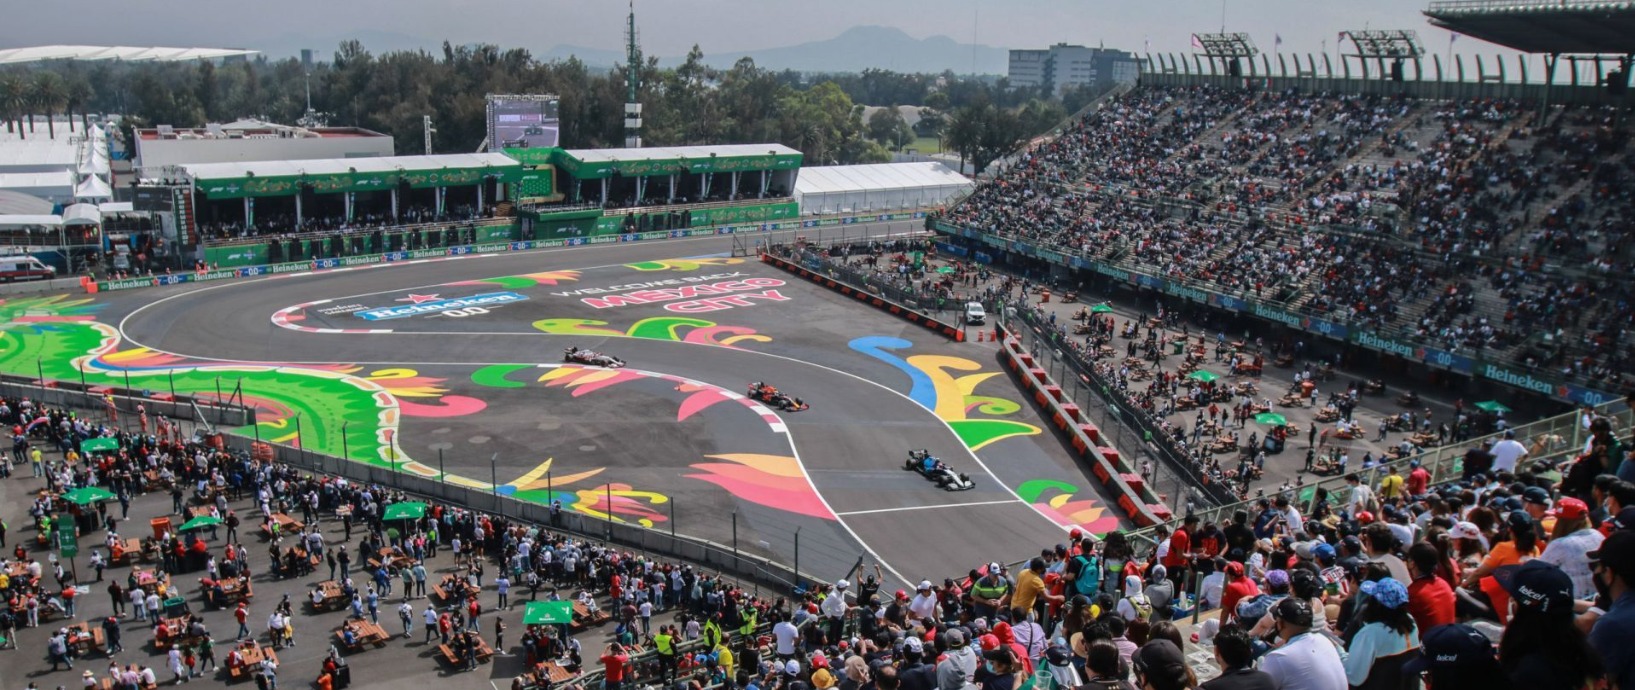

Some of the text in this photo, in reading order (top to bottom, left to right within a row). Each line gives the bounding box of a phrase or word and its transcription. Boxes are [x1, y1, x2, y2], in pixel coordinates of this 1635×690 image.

[477, 244, 506, 252] Heineken
[536, 240, 562, 248] Heineken
[346, 256, 379, 265] Heineken
[414, 250, 445, 258] Heineken
[194, 271, 233, 281] Heineken
[273, 262, 309, 273] Heineken
[108, 279, 151, 290] Heineken
[550, 271, 750, 296] WELCOME BACK
[1170, 282, 1207, 301] Heineken
[581, 278, 786, 309] MEXICO
[663, 289, 792, 313] CITY
[368, 294, 518, 319] Heineken
[1255, 304, 1299, 326] Heineken
[1358, 332, 1413, 357] Heineken
[1485, 365, 1552, 394] Heineken
[1519, 585, 1546, 601] telcel
